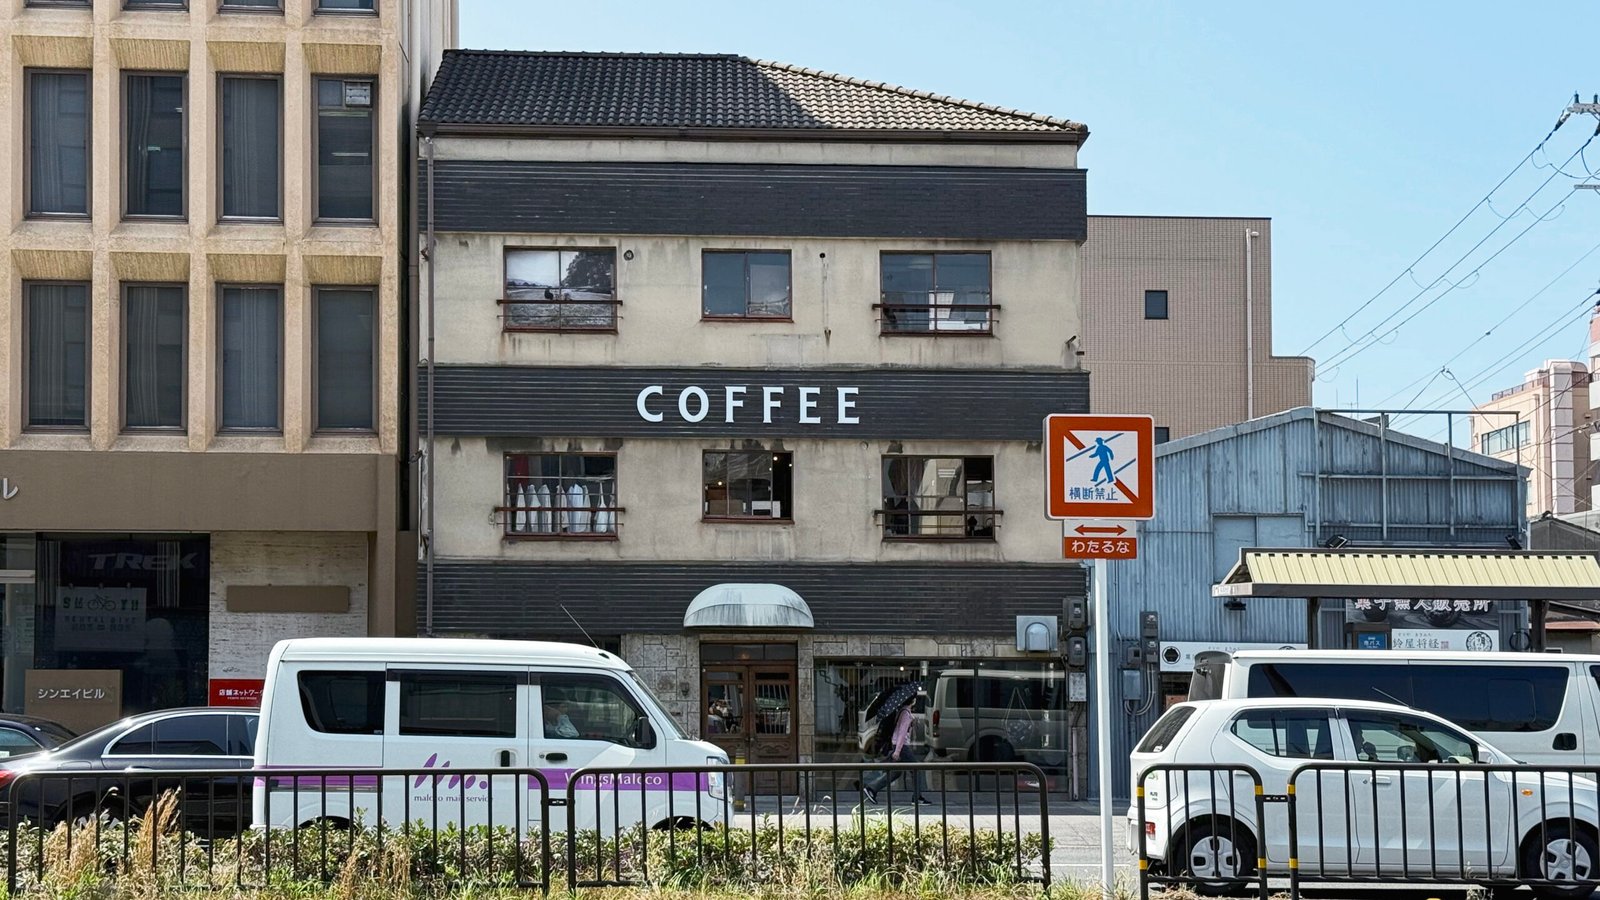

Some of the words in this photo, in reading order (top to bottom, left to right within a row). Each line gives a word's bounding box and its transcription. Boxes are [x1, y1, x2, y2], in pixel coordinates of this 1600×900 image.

[636, 386, 860, 424] COFFEE
[1069, 487, 1118, 501] 横断禁止
[1071, 540, 1130, 554] わたるな
[88, 552, 198, 570] TREK
[37, 688, 105, 700] シンエイビル
[414, 794, 444, 802] maloo
[446, 794, 464, 802] mai
[466, 794, 493, 802] servic
